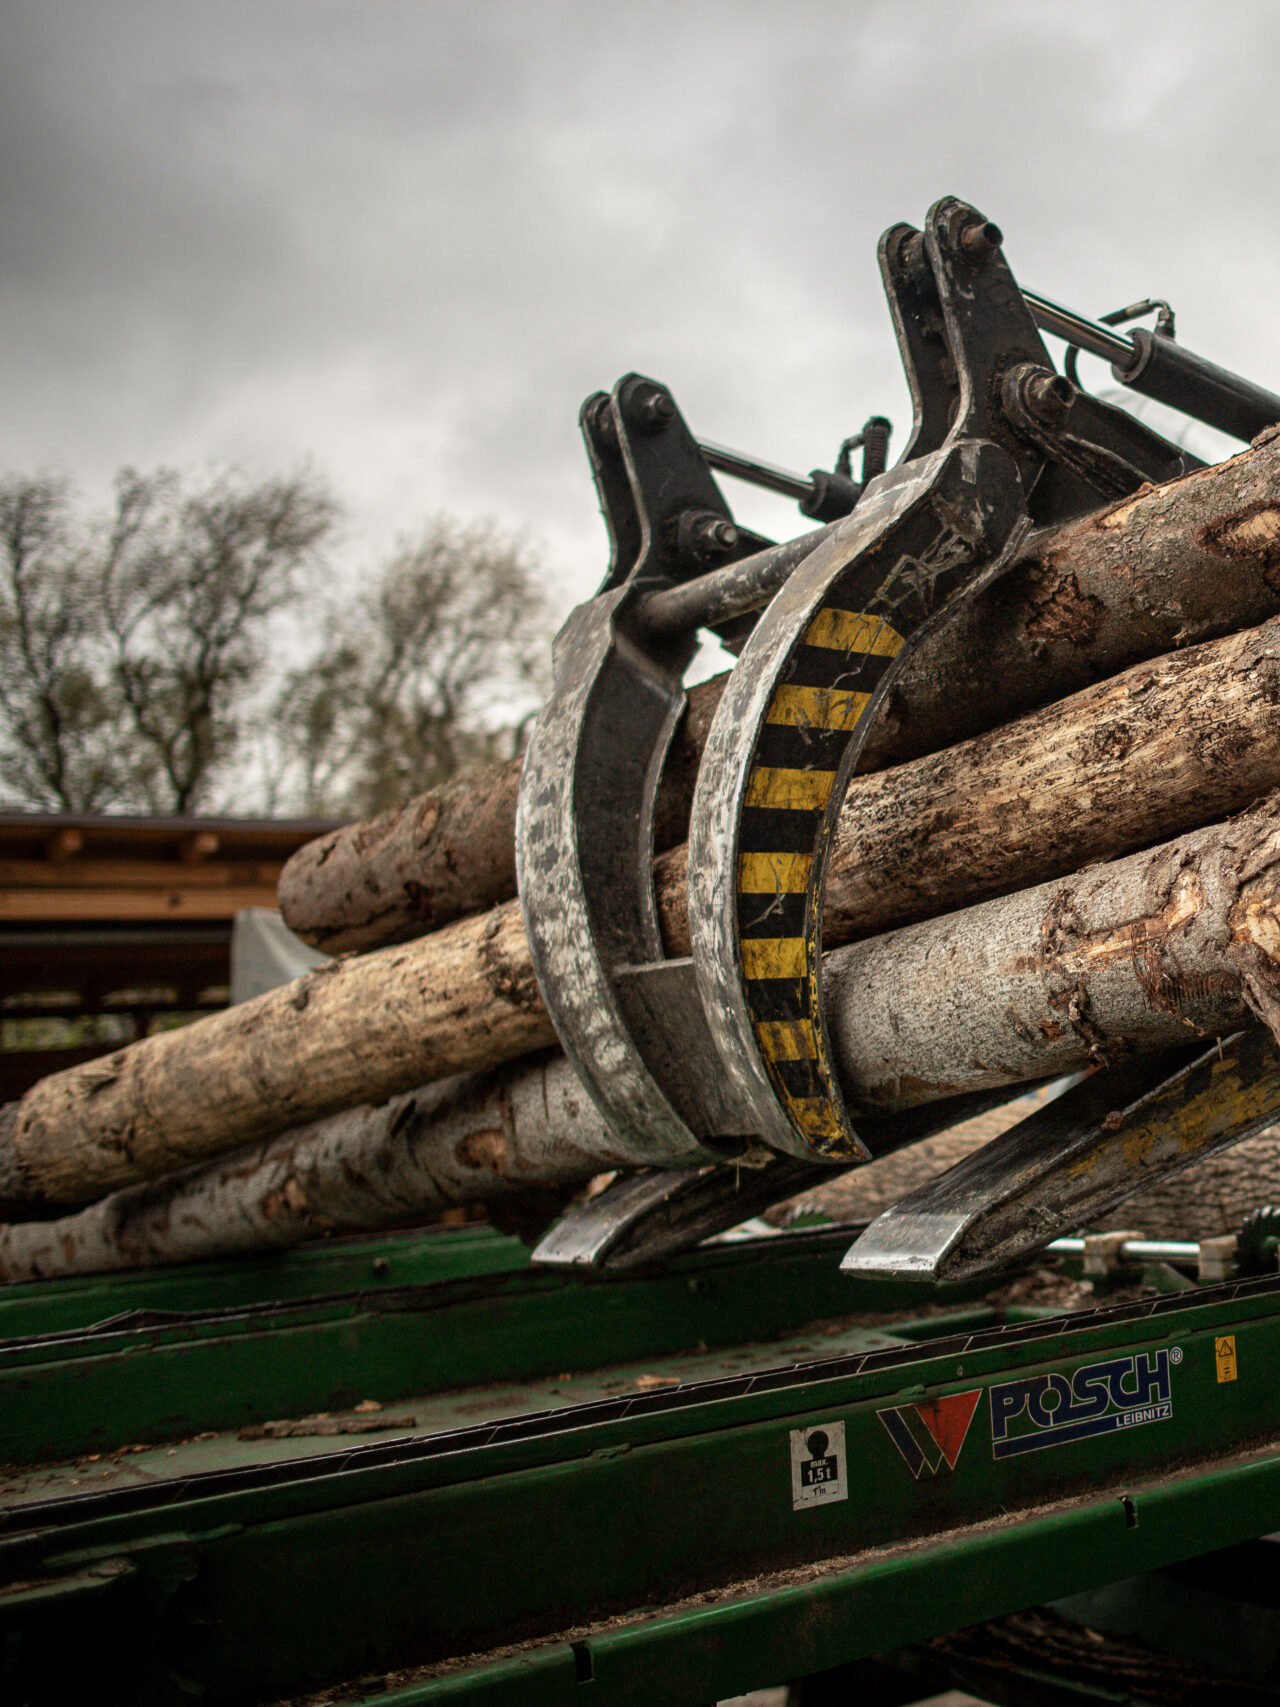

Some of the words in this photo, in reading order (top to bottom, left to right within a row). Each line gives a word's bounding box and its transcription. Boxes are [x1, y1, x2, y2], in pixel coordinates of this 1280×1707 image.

[990, 1349, 1172, 1440] POSCH
[1115, 1406, 1170, 1428] LEIBNITZ
[810, 1459, 828, 1468] max.
